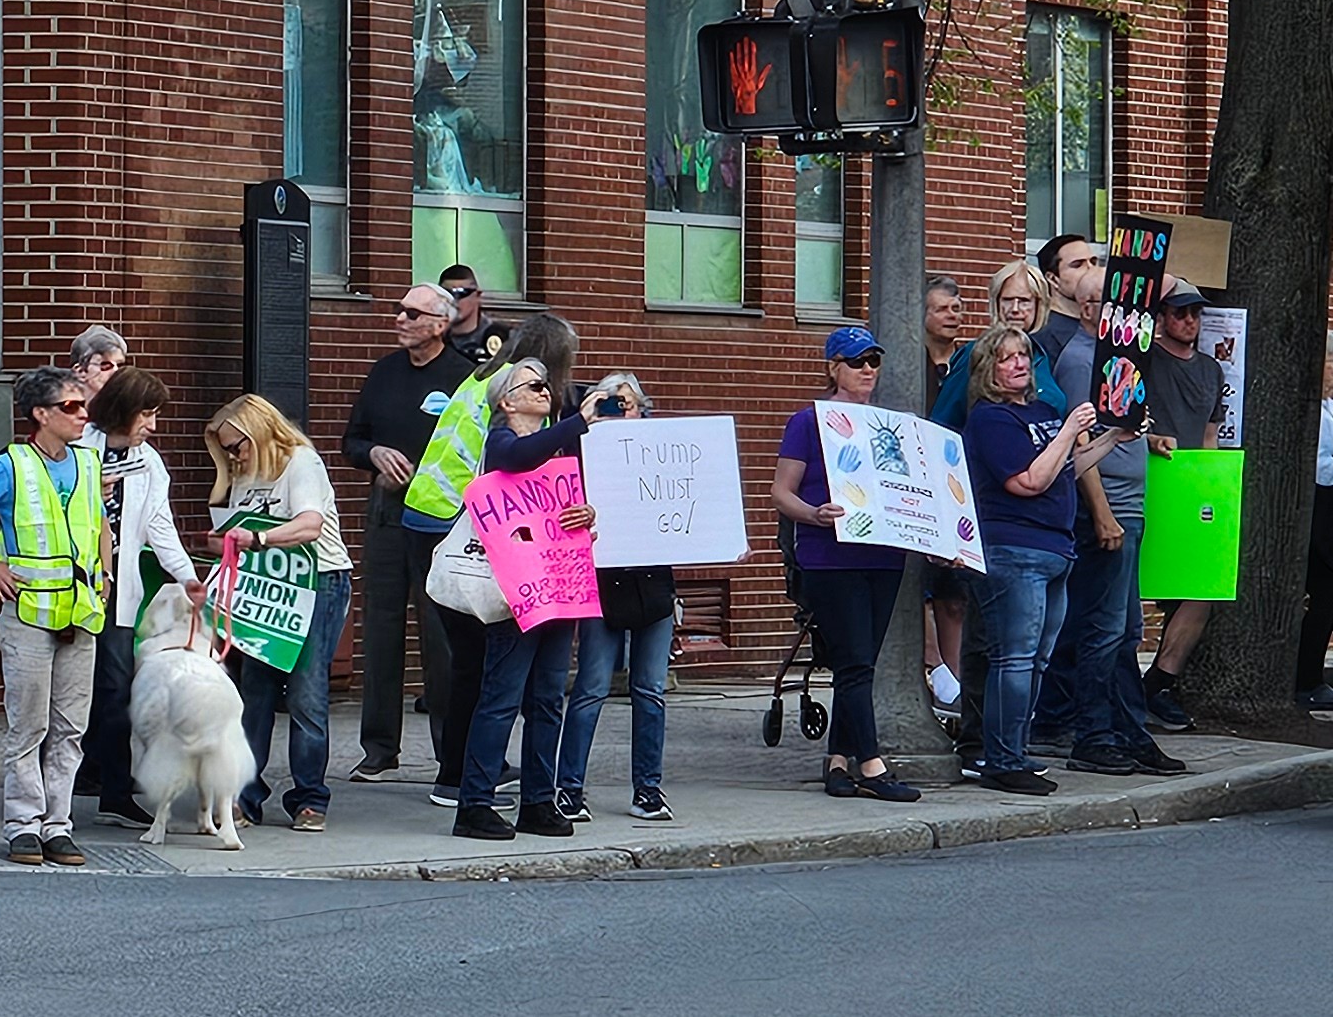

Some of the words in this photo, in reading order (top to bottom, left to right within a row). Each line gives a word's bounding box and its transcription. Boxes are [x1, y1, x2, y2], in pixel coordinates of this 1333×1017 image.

[1111, 227, 1167, 261] HANDS
[618, 438, 702, 475] Trump
[657, 500, 696, 534] GO!
